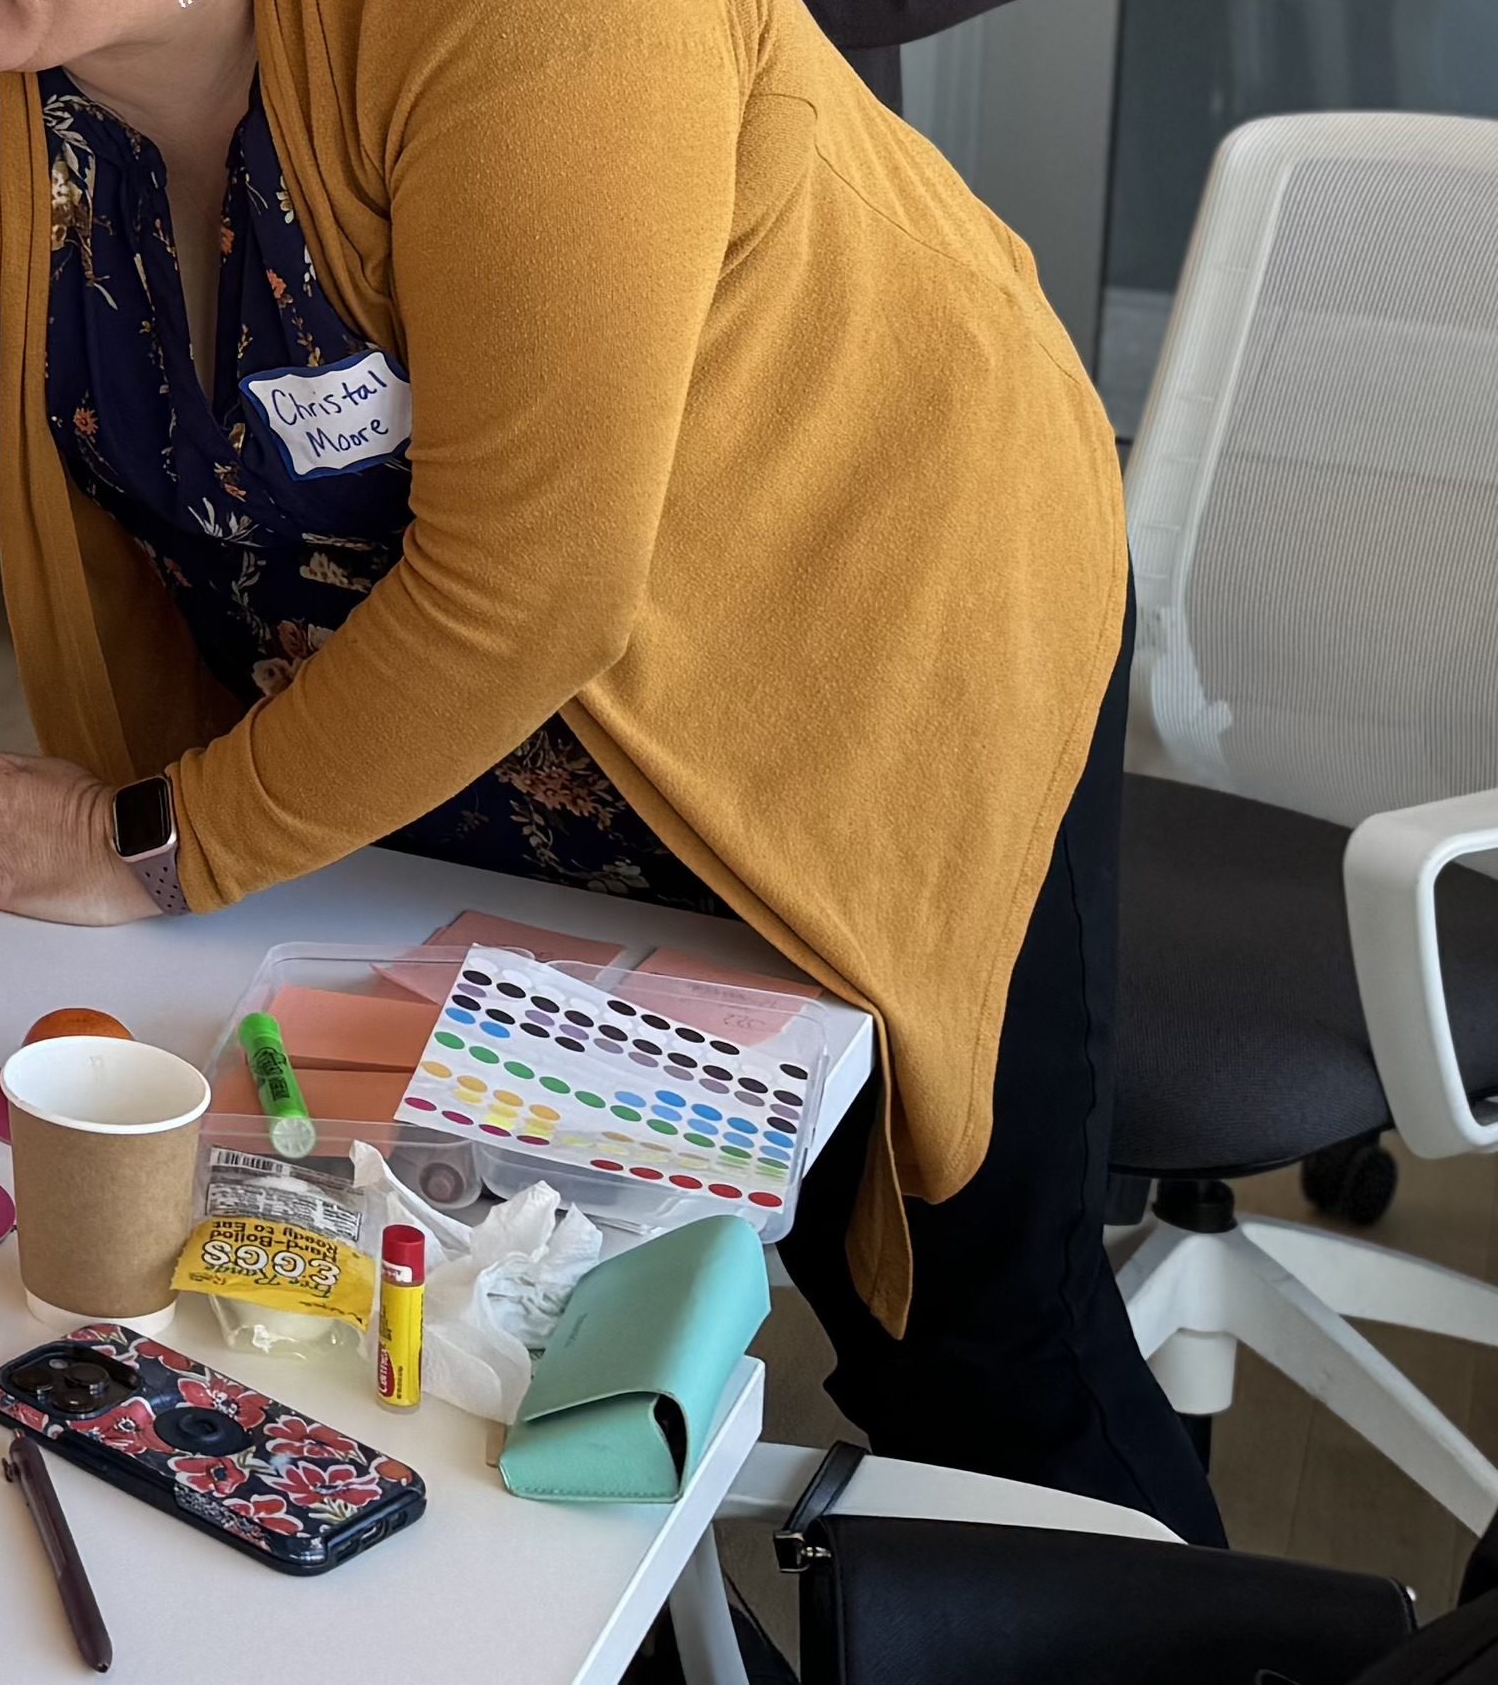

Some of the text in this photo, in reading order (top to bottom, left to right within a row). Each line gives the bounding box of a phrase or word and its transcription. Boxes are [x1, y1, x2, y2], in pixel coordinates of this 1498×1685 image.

[271, 370, 388, 426] Christal
[306, 418, 389, 458] Moore
[209, 1229, 337, 1263] Hard-Boiled
[212, 1220, 338, 1255] Ready to Eat
[201, 1239, 342, 1287] EGGS
